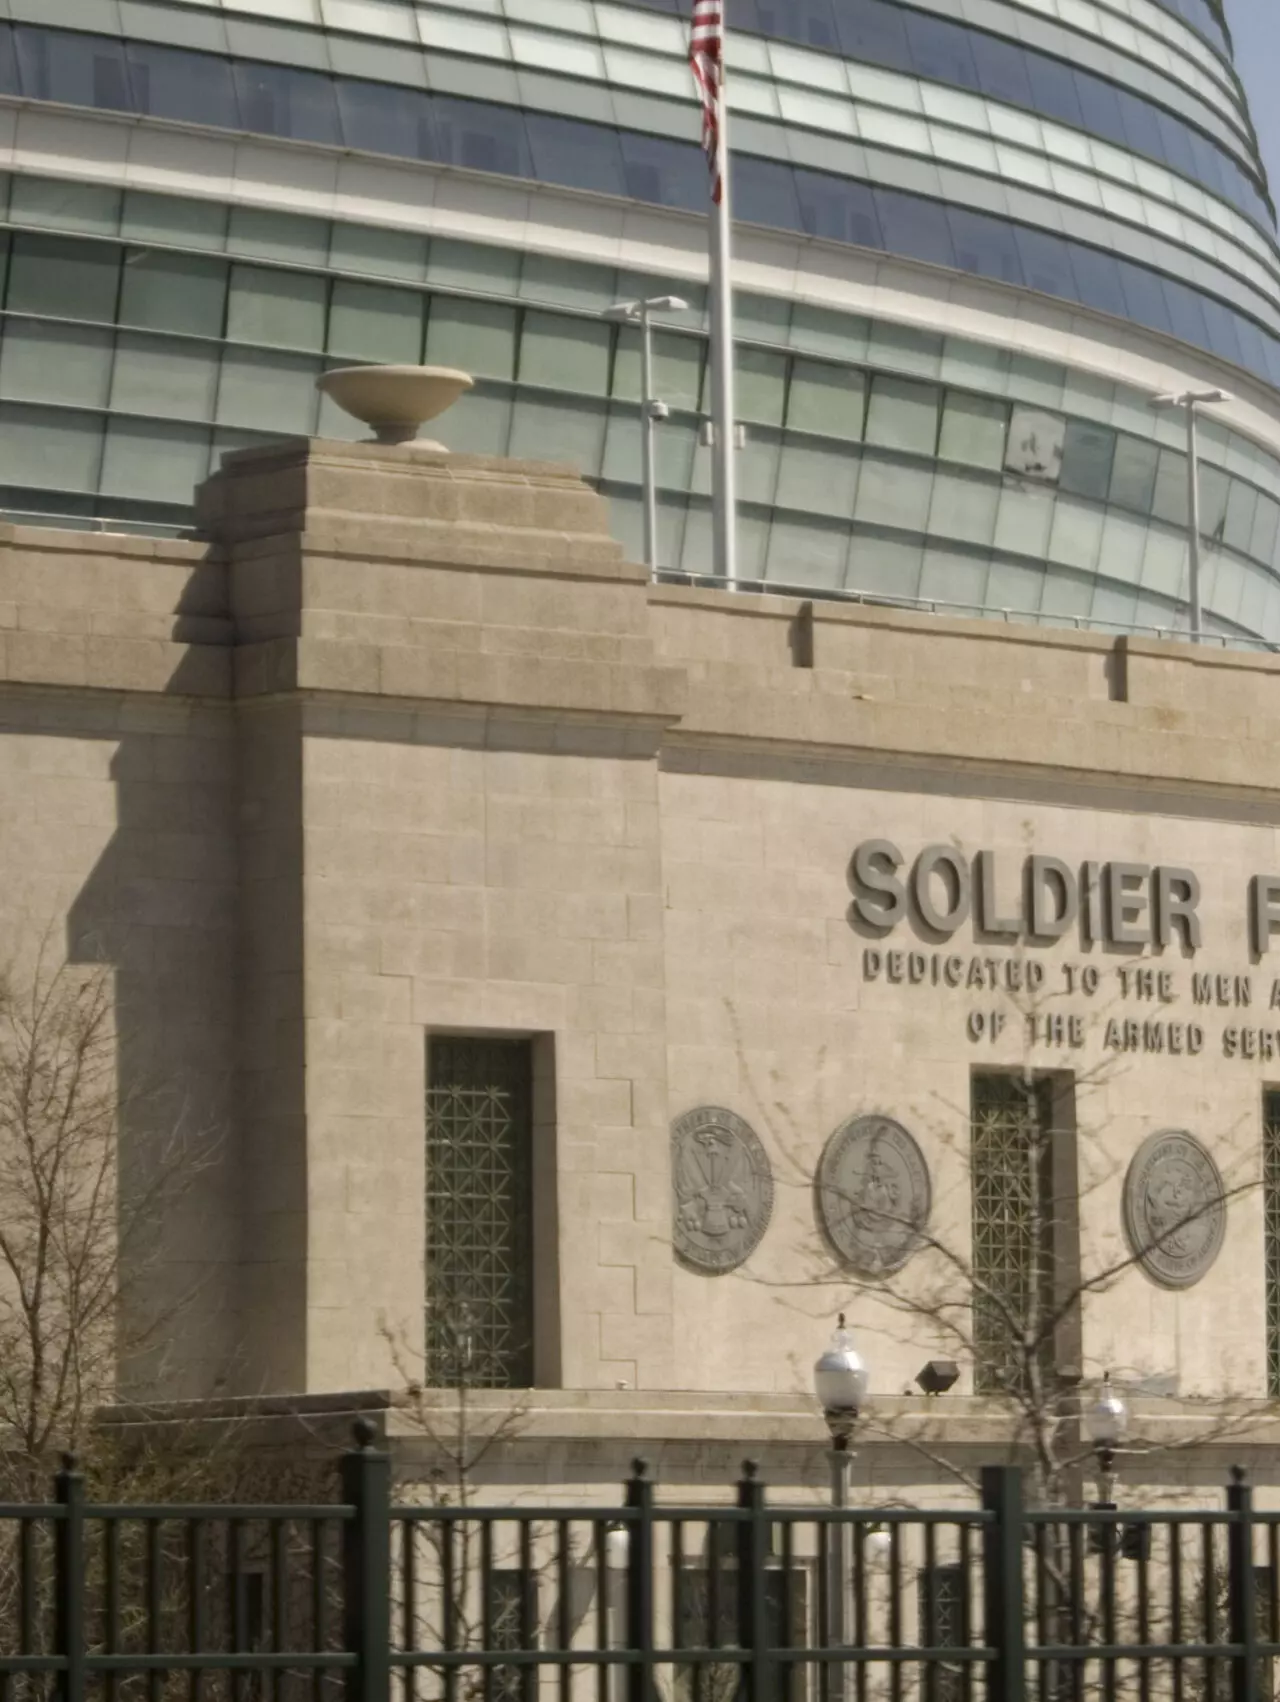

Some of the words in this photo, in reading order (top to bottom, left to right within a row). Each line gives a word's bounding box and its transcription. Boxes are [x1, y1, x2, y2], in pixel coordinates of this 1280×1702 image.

[847, 839, 1201, 958] SOLDIER
[862, 948, 1045, 993] DEDICATED
[1062, 963, 1099, 996] TO
[1117, 966, 1174, 1003] THE
[1191, 972, 1251, 1008] MEN
[966, 1009, 1005, 1044] OF
[1025, 1012, 1085, 1049] THE
[1103, 1017, 1204, 1056] ARMED
